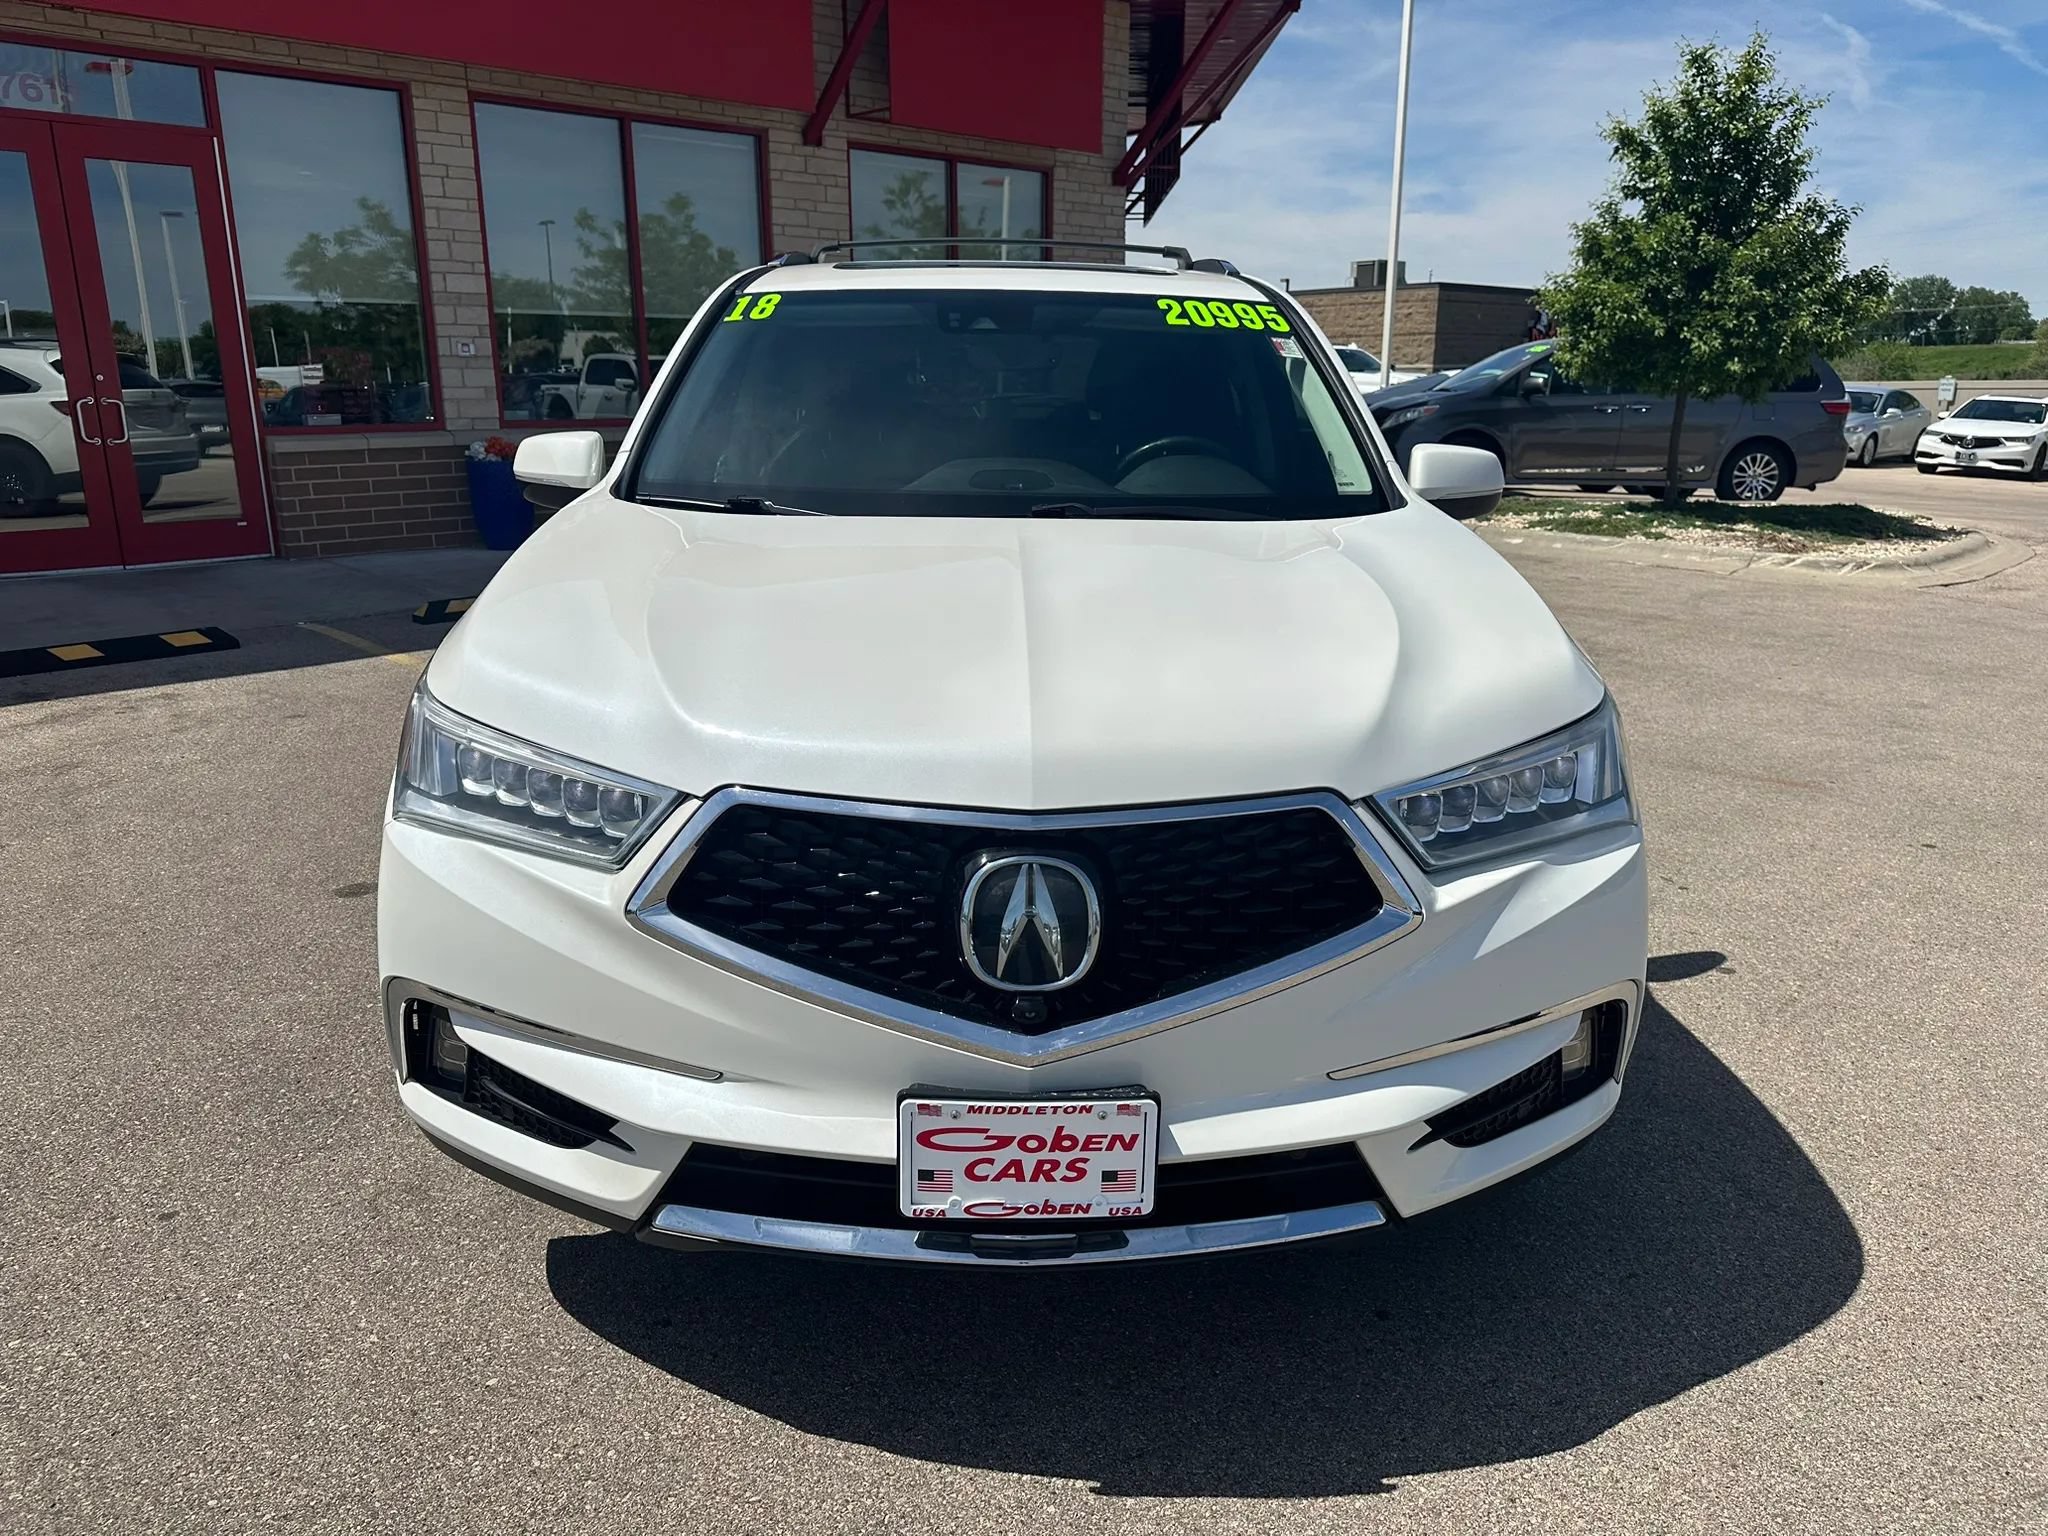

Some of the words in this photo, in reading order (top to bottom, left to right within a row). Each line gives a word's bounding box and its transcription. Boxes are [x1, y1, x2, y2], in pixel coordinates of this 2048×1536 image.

[723, 293, 782, 322] 18
[1157, 299, 1291, 332] 20995
[966, 1104, 1094, 1115] MIDDLETON
[964, 1157, 1091, 1183] CARS
[912, 1208, 947, 1218] USA
[1108, 1206, 1142, 1216] USA
